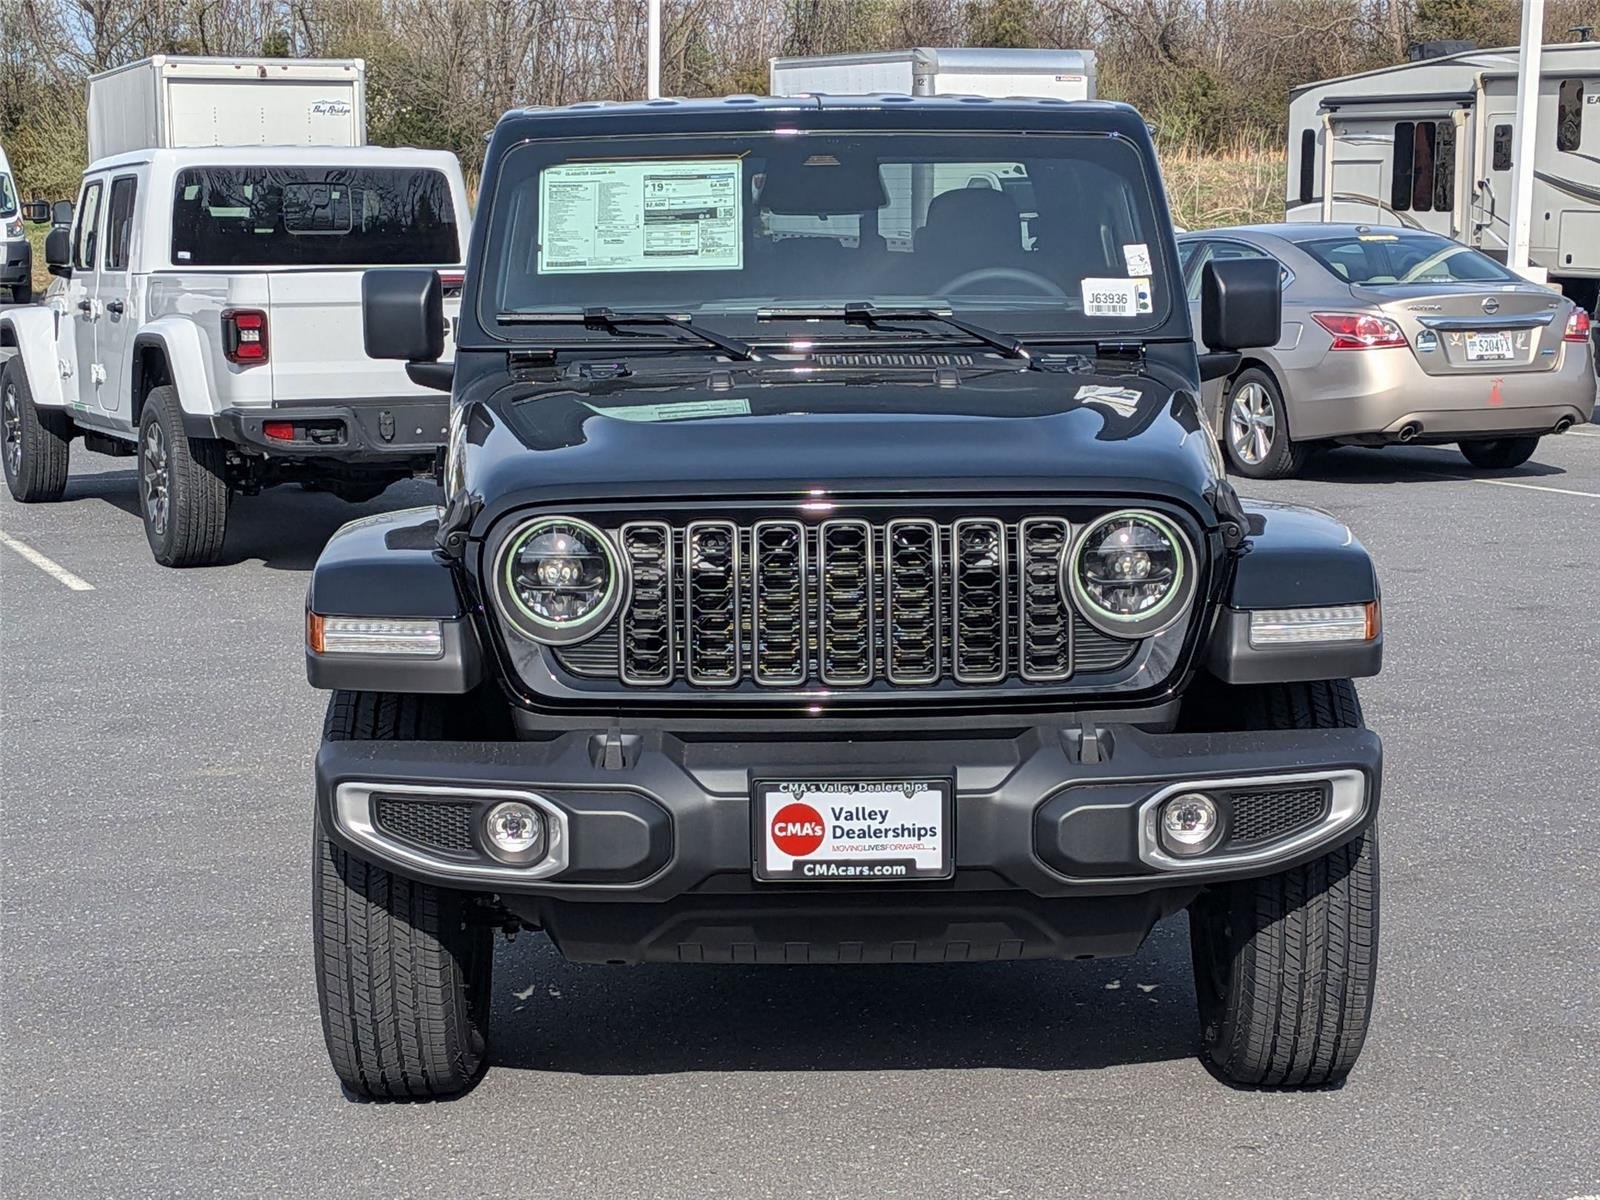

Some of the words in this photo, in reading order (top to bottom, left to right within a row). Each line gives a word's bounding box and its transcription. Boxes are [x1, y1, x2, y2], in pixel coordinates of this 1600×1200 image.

[651, 183, 664, 192] 19
[1089, 292, 1128, 304] J63936
[779, 783, 816, 793] CMA's
[820, 783, 855, 795] Valley
[859, 782, 928, 794] Dealerships
[831, 806, 889, 824] Valley
[774, 821, 823, 837] CMA's
[832, 823, 937, 841] Dealerships
[803, 863, 906, 876] CMAcars.com
